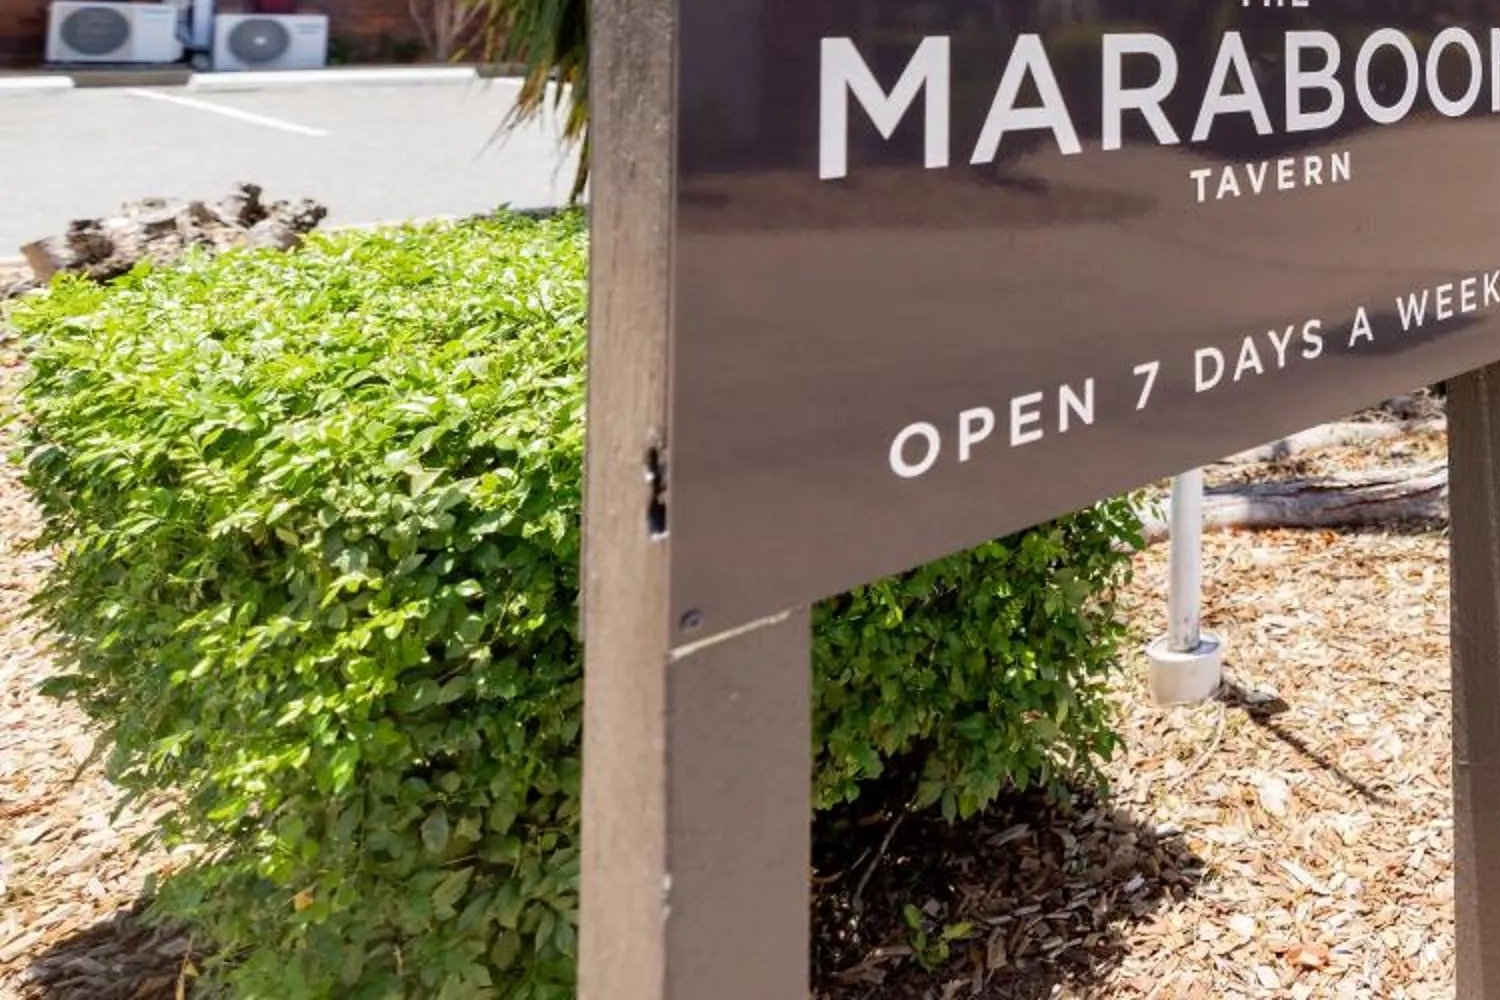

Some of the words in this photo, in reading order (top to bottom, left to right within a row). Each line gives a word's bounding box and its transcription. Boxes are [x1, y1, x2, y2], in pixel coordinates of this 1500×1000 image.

[1189, 151, 1352, 203] TAVERN
[888, 377, 1095, 478] OPEN
[1132, 360, 1161, 411] 7
[1193, 319, 1324, 393] DAYS
[1347, 306, 1374, 347] A
